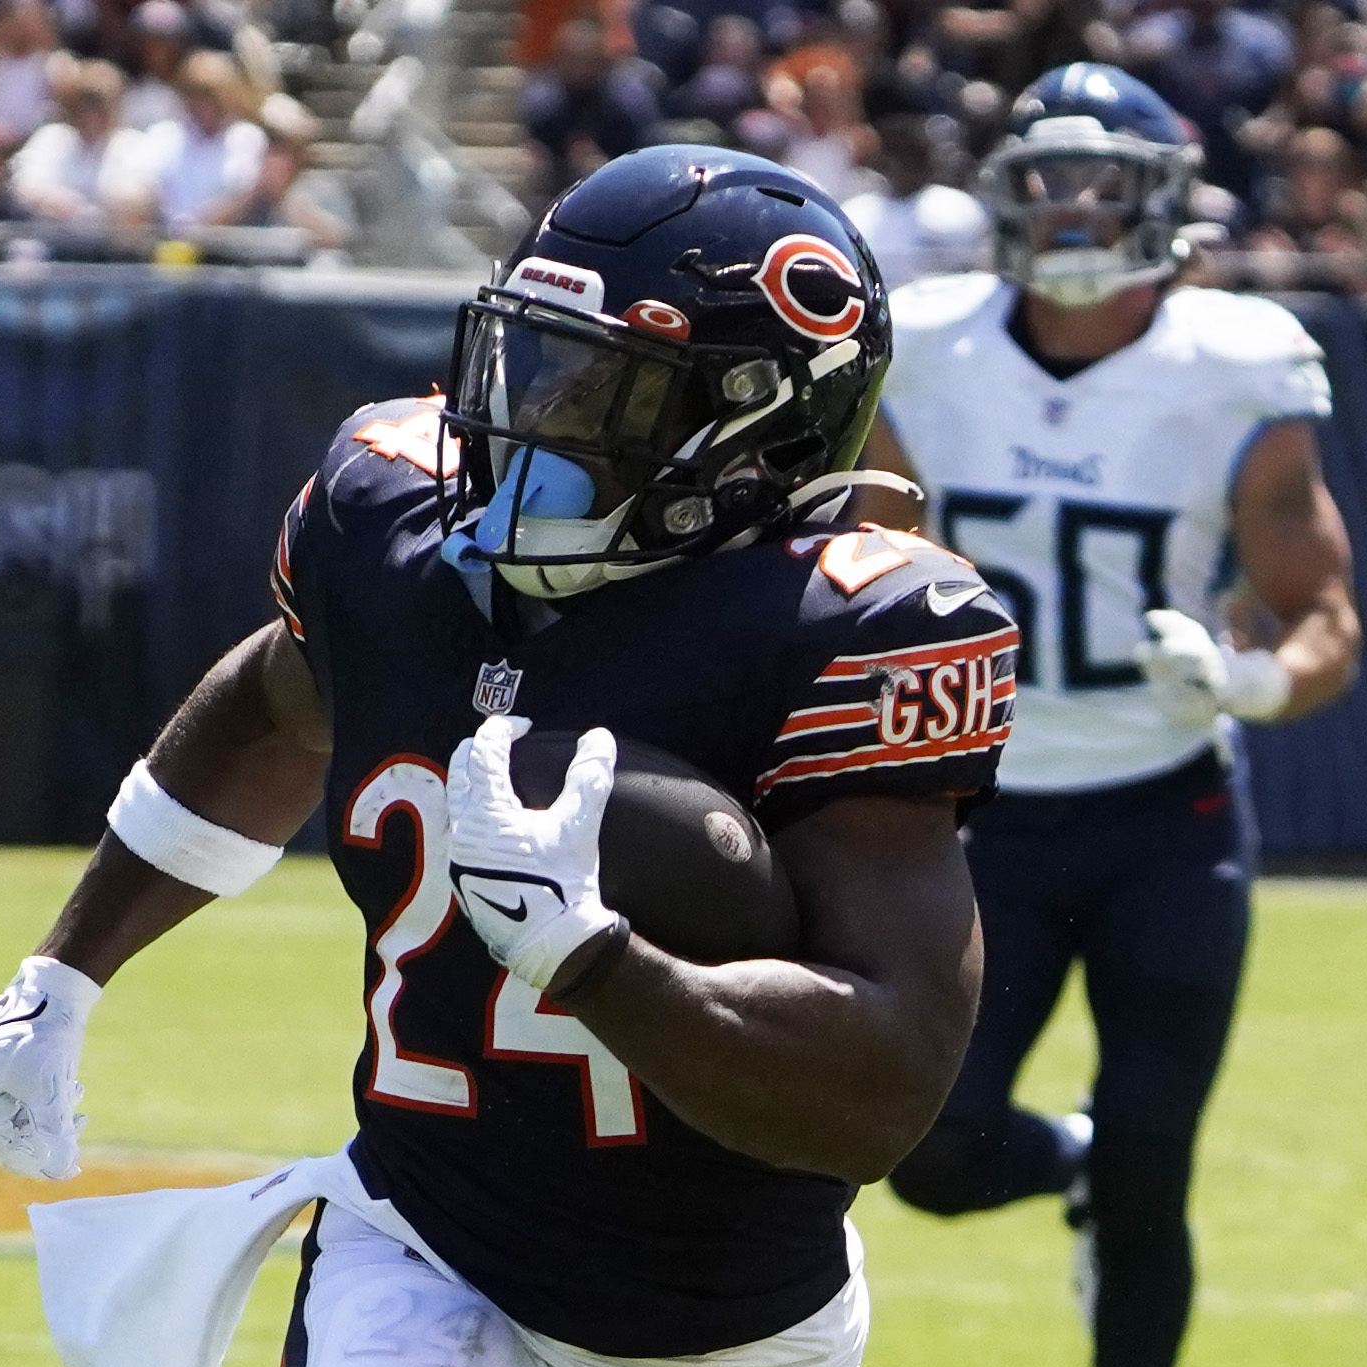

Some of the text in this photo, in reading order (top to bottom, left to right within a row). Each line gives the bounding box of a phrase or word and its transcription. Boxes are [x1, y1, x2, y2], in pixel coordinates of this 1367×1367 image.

[520, 267, 587, 295] BEARS
[939, 485, 1181, 691] 50
[479, 684, 510, 709] NFL
[878, 653, 994, 747] GSH
